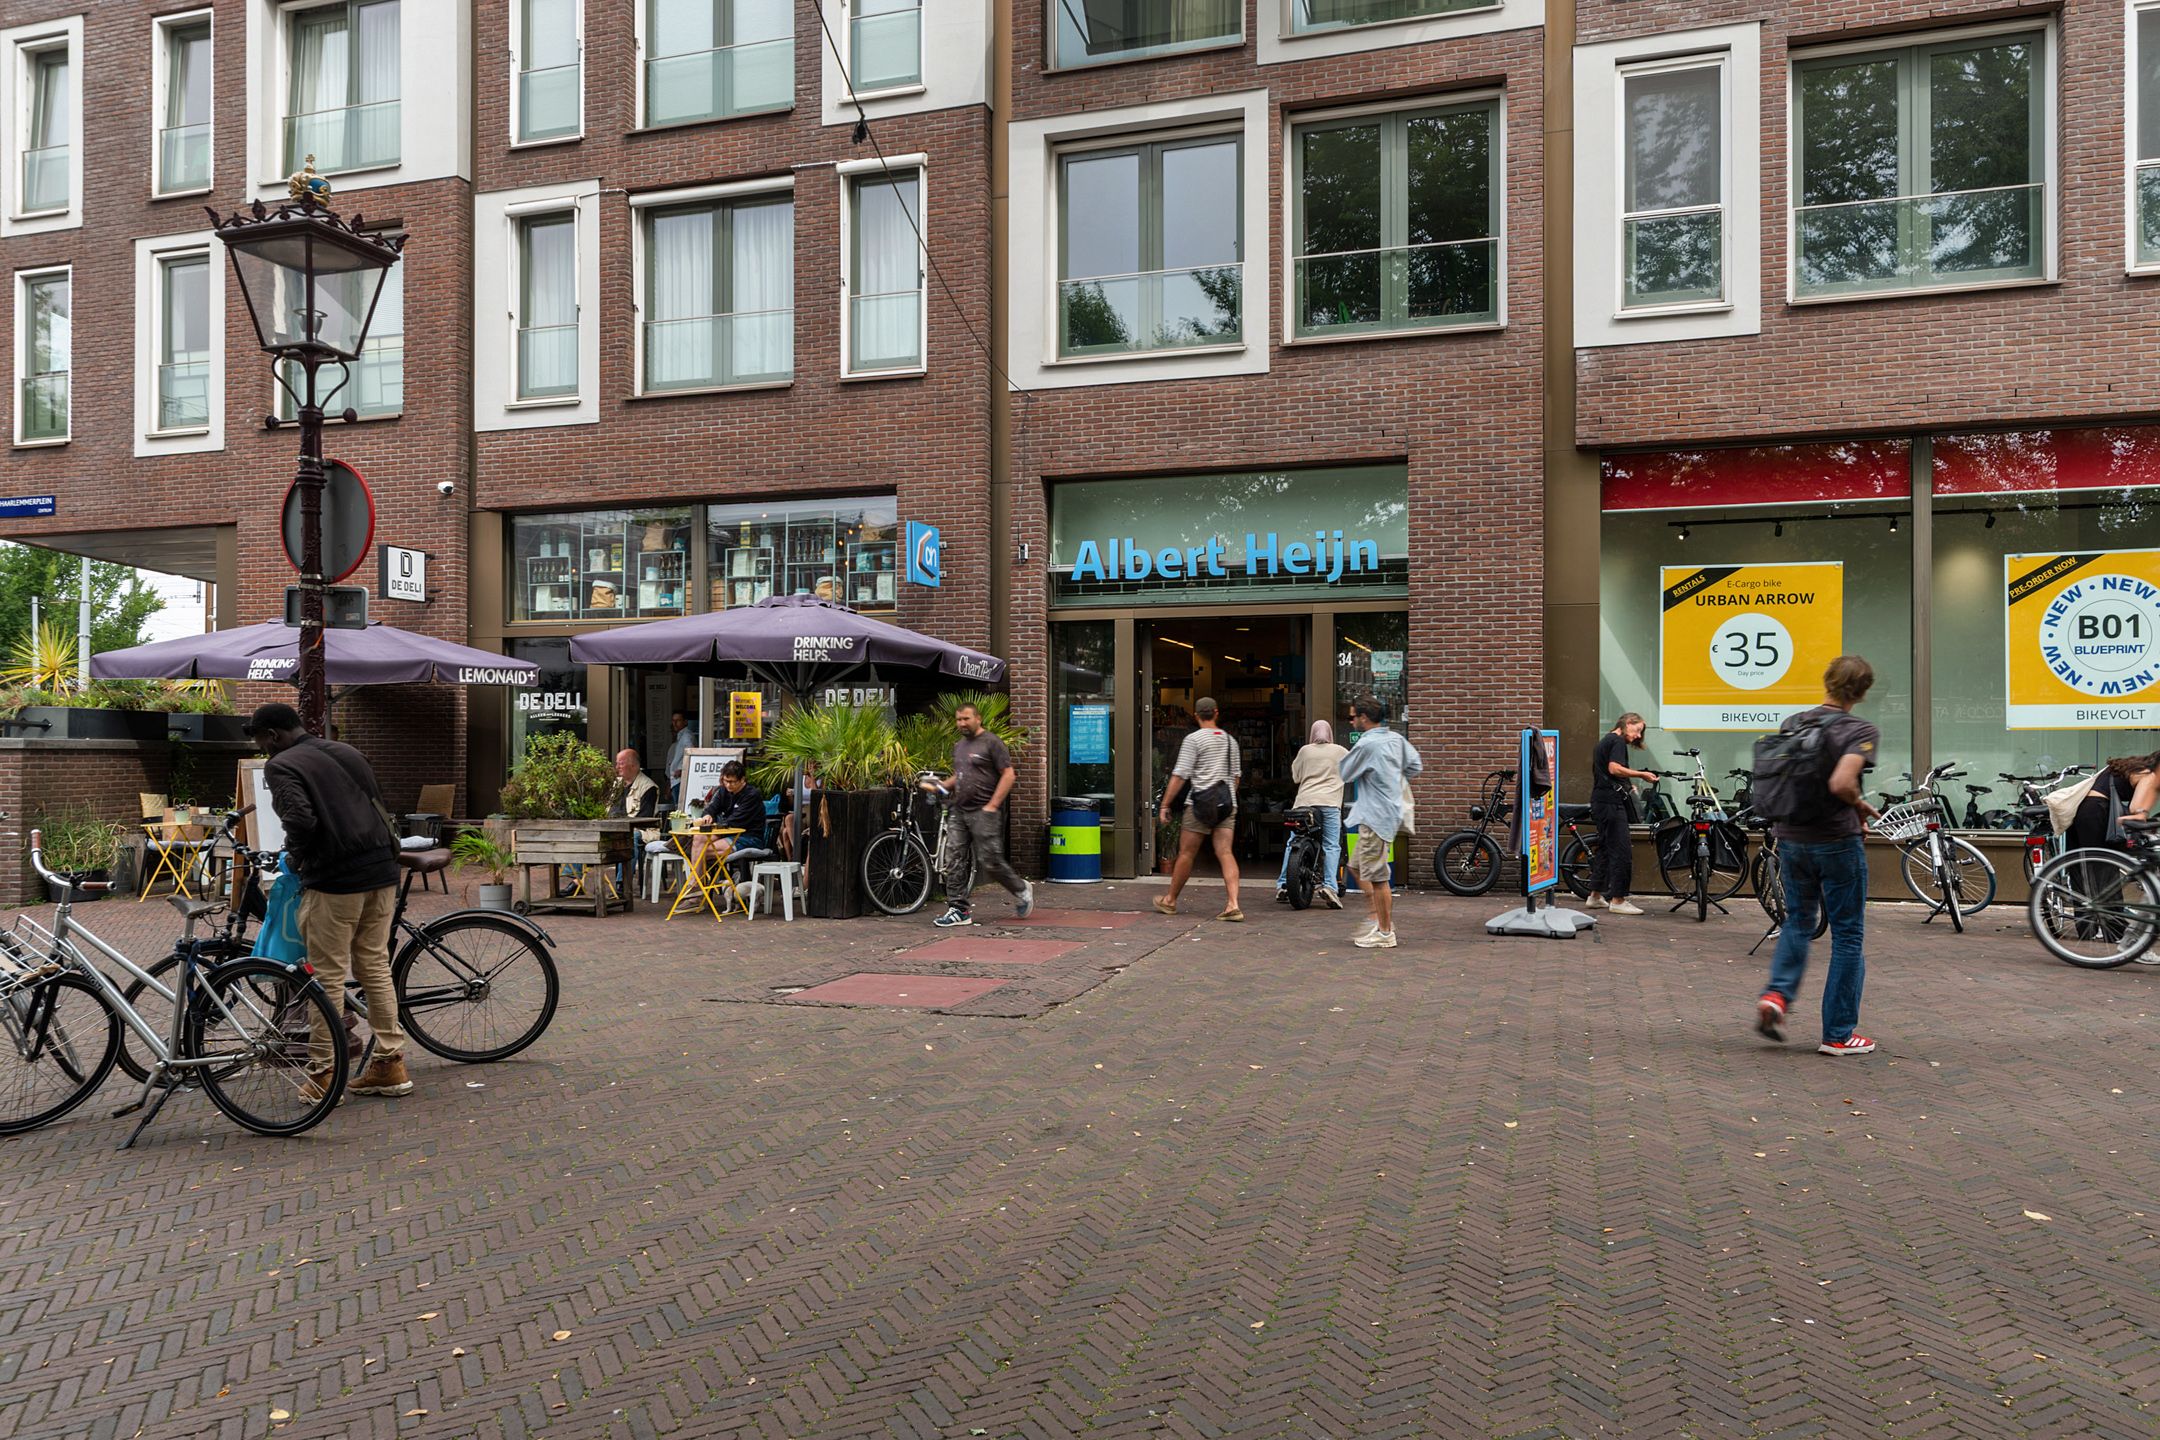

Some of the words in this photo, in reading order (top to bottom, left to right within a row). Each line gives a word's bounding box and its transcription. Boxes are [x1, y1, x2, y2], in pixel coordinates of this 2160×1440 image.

[1071, 535, 1226, 580] Albert
[1246, 530, 1378, 582] Heijn
[1727, 580, 1761, 589] E-Cargo
[1763, 579, 1782, 587] bike
[2009, 568, 2054, 599] PRE-ORDER
[2053, 556, 2078, 574] NOW
[392, 580, 402, 590] DE
[404, 581, 421, 592] DELI
[1672, 575, 1706, 597] RENTALS
[2103, 577, 2157, 600] NEW
[1695, 595, 1750, 606] URBAN
[1755, 593, 1815, 605] ARROW
[2044, 584, 2083, 628] NEW
[2078, 614, 2140, 639] B01
[794, 636, 854, 649] DRINKING
[1724, 632, 1779, 667] 35
[2074, 644, 2145, 655] BLUEPRINT
[793, 649, 831, 661] HELPS.
[1338, 652, 1352, 666] 34
[250, 659, 296, 669] DRINKING
[2043, 645, 2083, 686] NEW
[247, 669, 274, 679] HELPS.
[2100, 670, 2154, 694] NEW
[519, 693, 541, 710] DE
[544, 692, 580, 710] DELI
[825, 689, 850, 707] DE
[853, 688, 895, 707] DELI
[1721, 713, 1780, 722] BIKEVOLT
[2076, 709, 2146, 721] BIKEVOLT
[694, 762, 708, 773] DE
